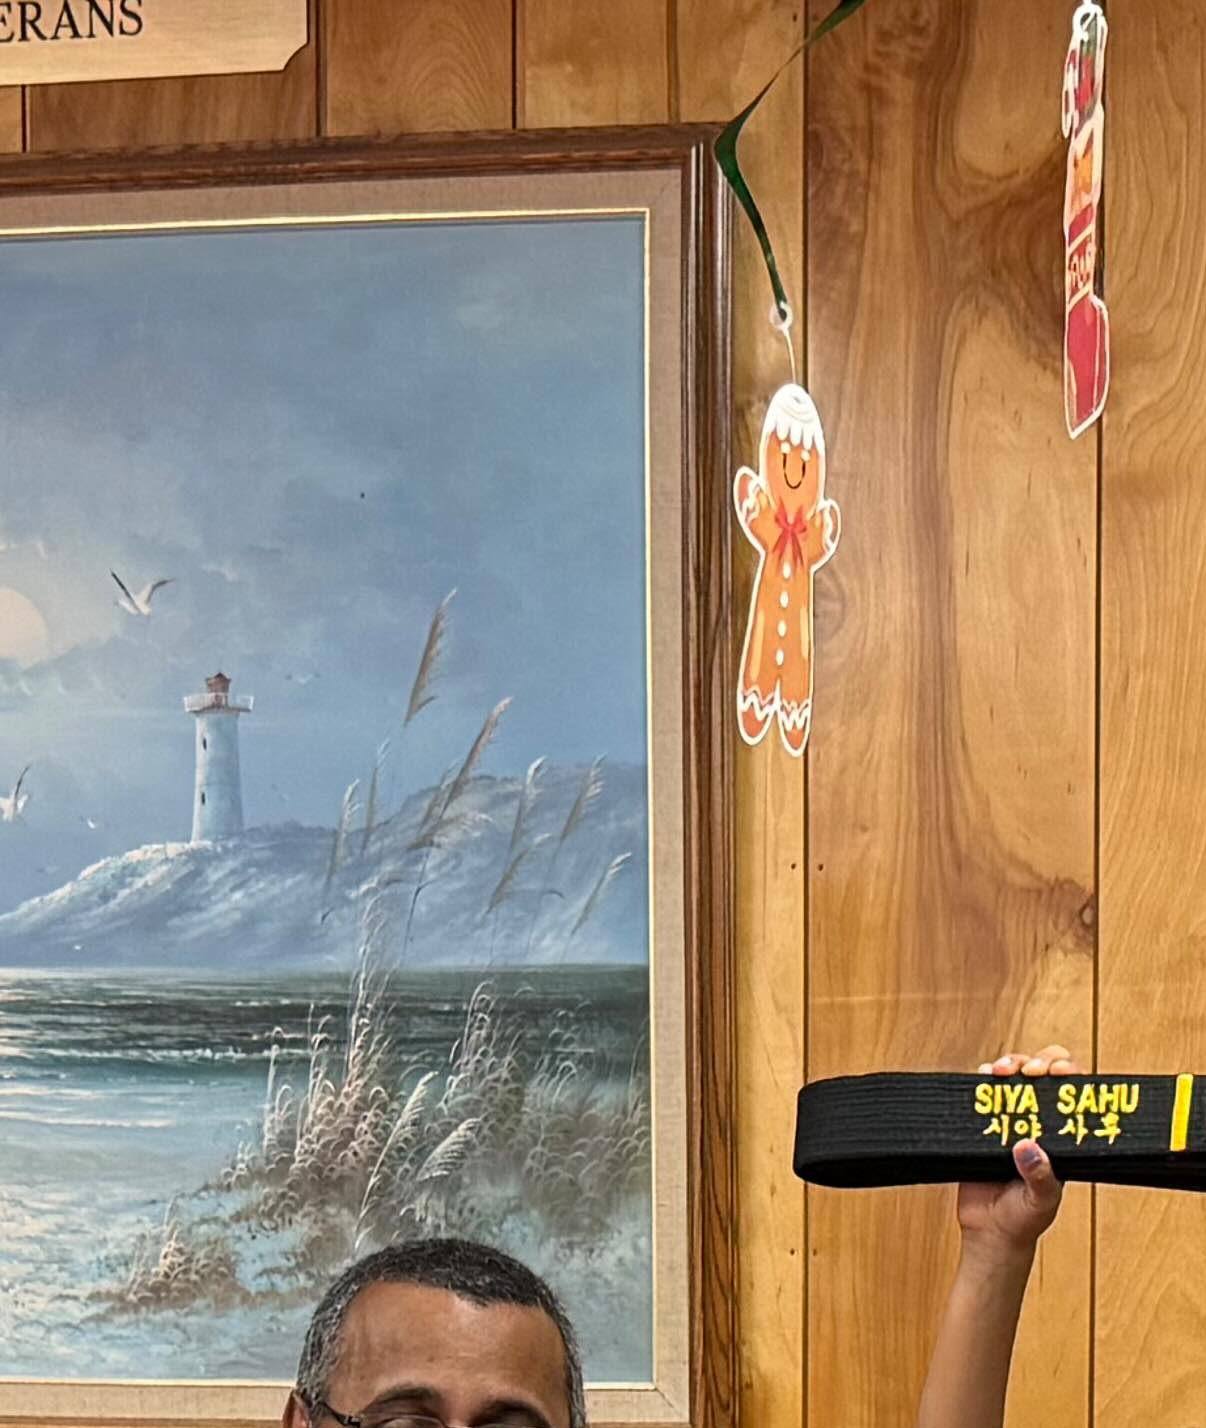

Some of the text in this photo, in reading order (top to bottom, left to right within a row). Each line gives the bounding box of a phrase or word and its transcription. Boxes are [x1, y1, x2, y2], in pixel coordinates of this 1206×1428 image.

[974, 1082, 1141, 1118] SIYA SAHU
[983, 1112, 1123, 1147] 시야 사후
